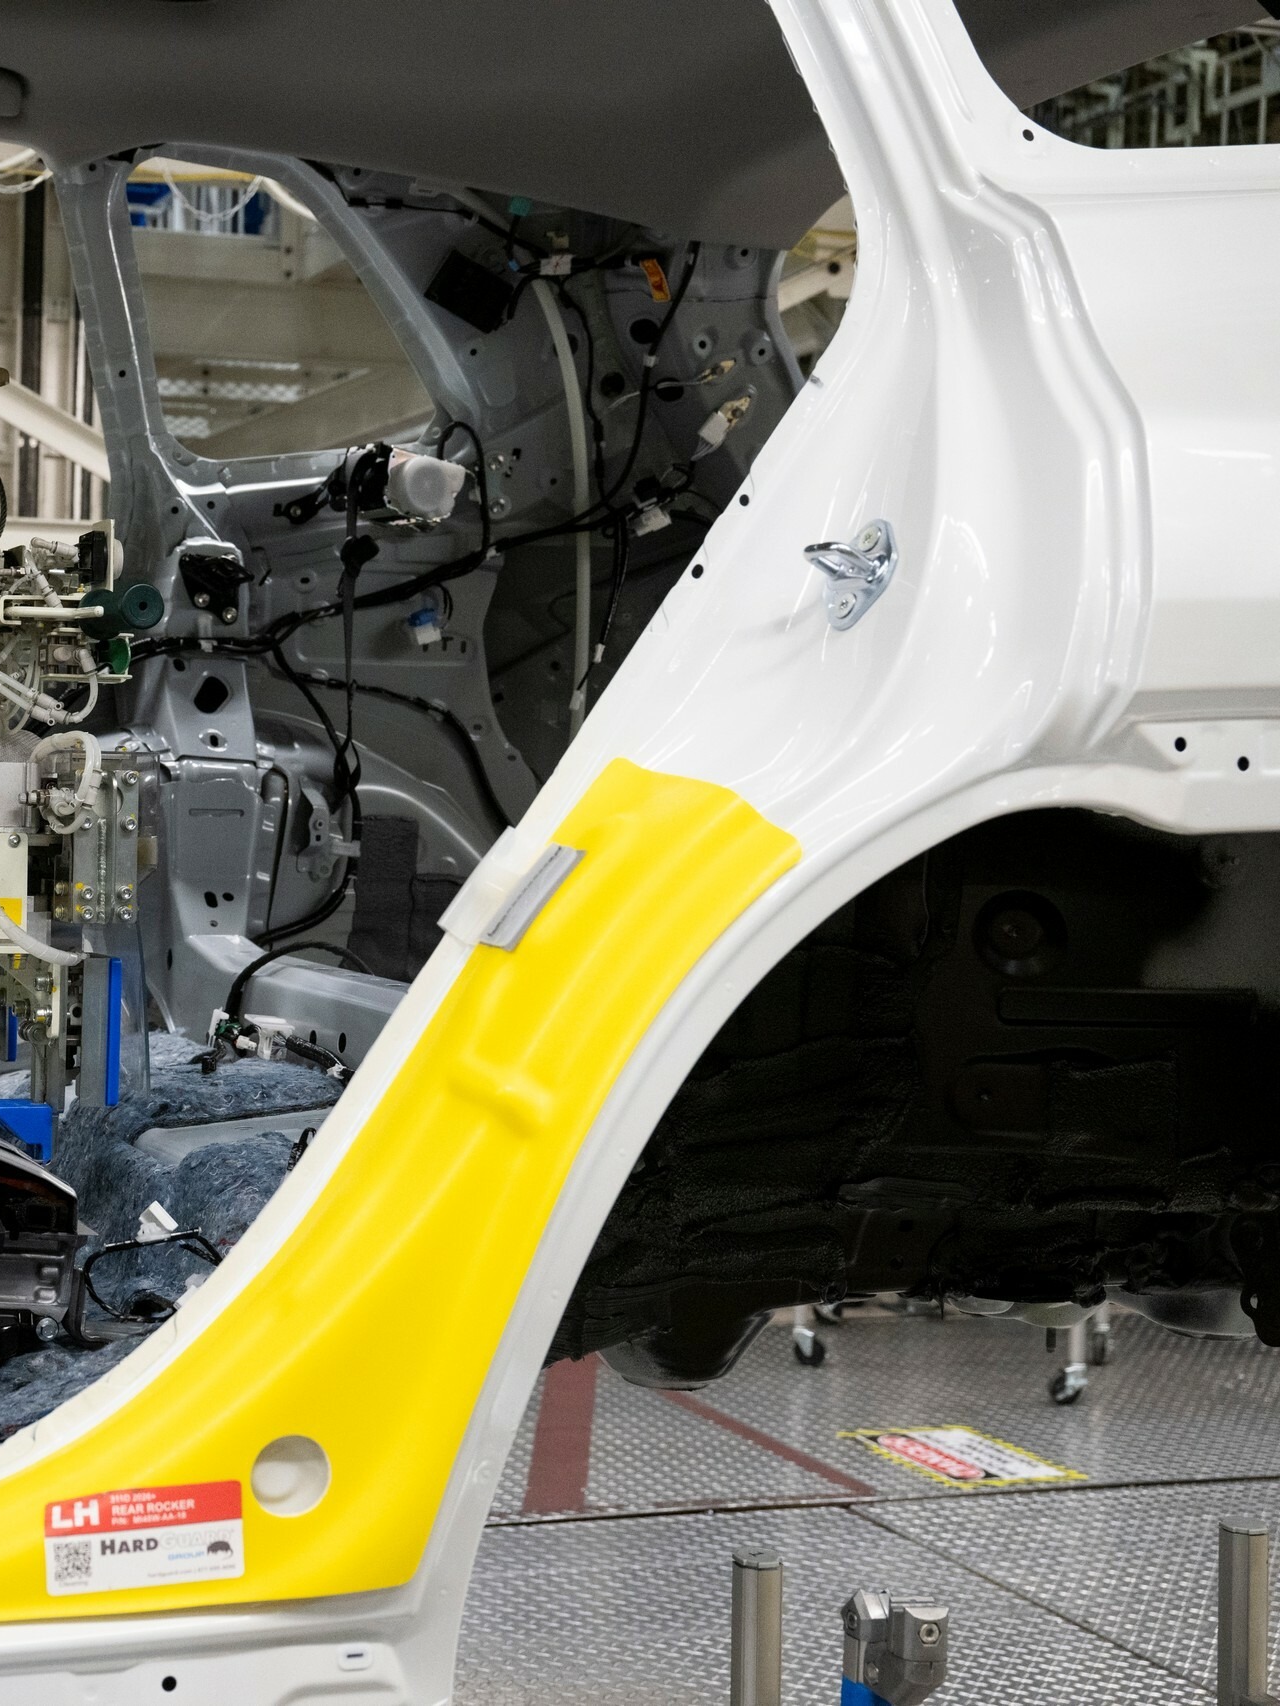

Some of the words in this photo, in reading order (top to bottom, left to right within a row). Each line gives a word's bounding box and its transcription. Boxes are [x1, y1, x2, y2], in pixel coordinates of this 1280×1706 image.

[51, 1499, 100, 1529] LH
[112, 1503, 144, 1516] REAR
[146, 1498, 195, 1513] ROCKER
